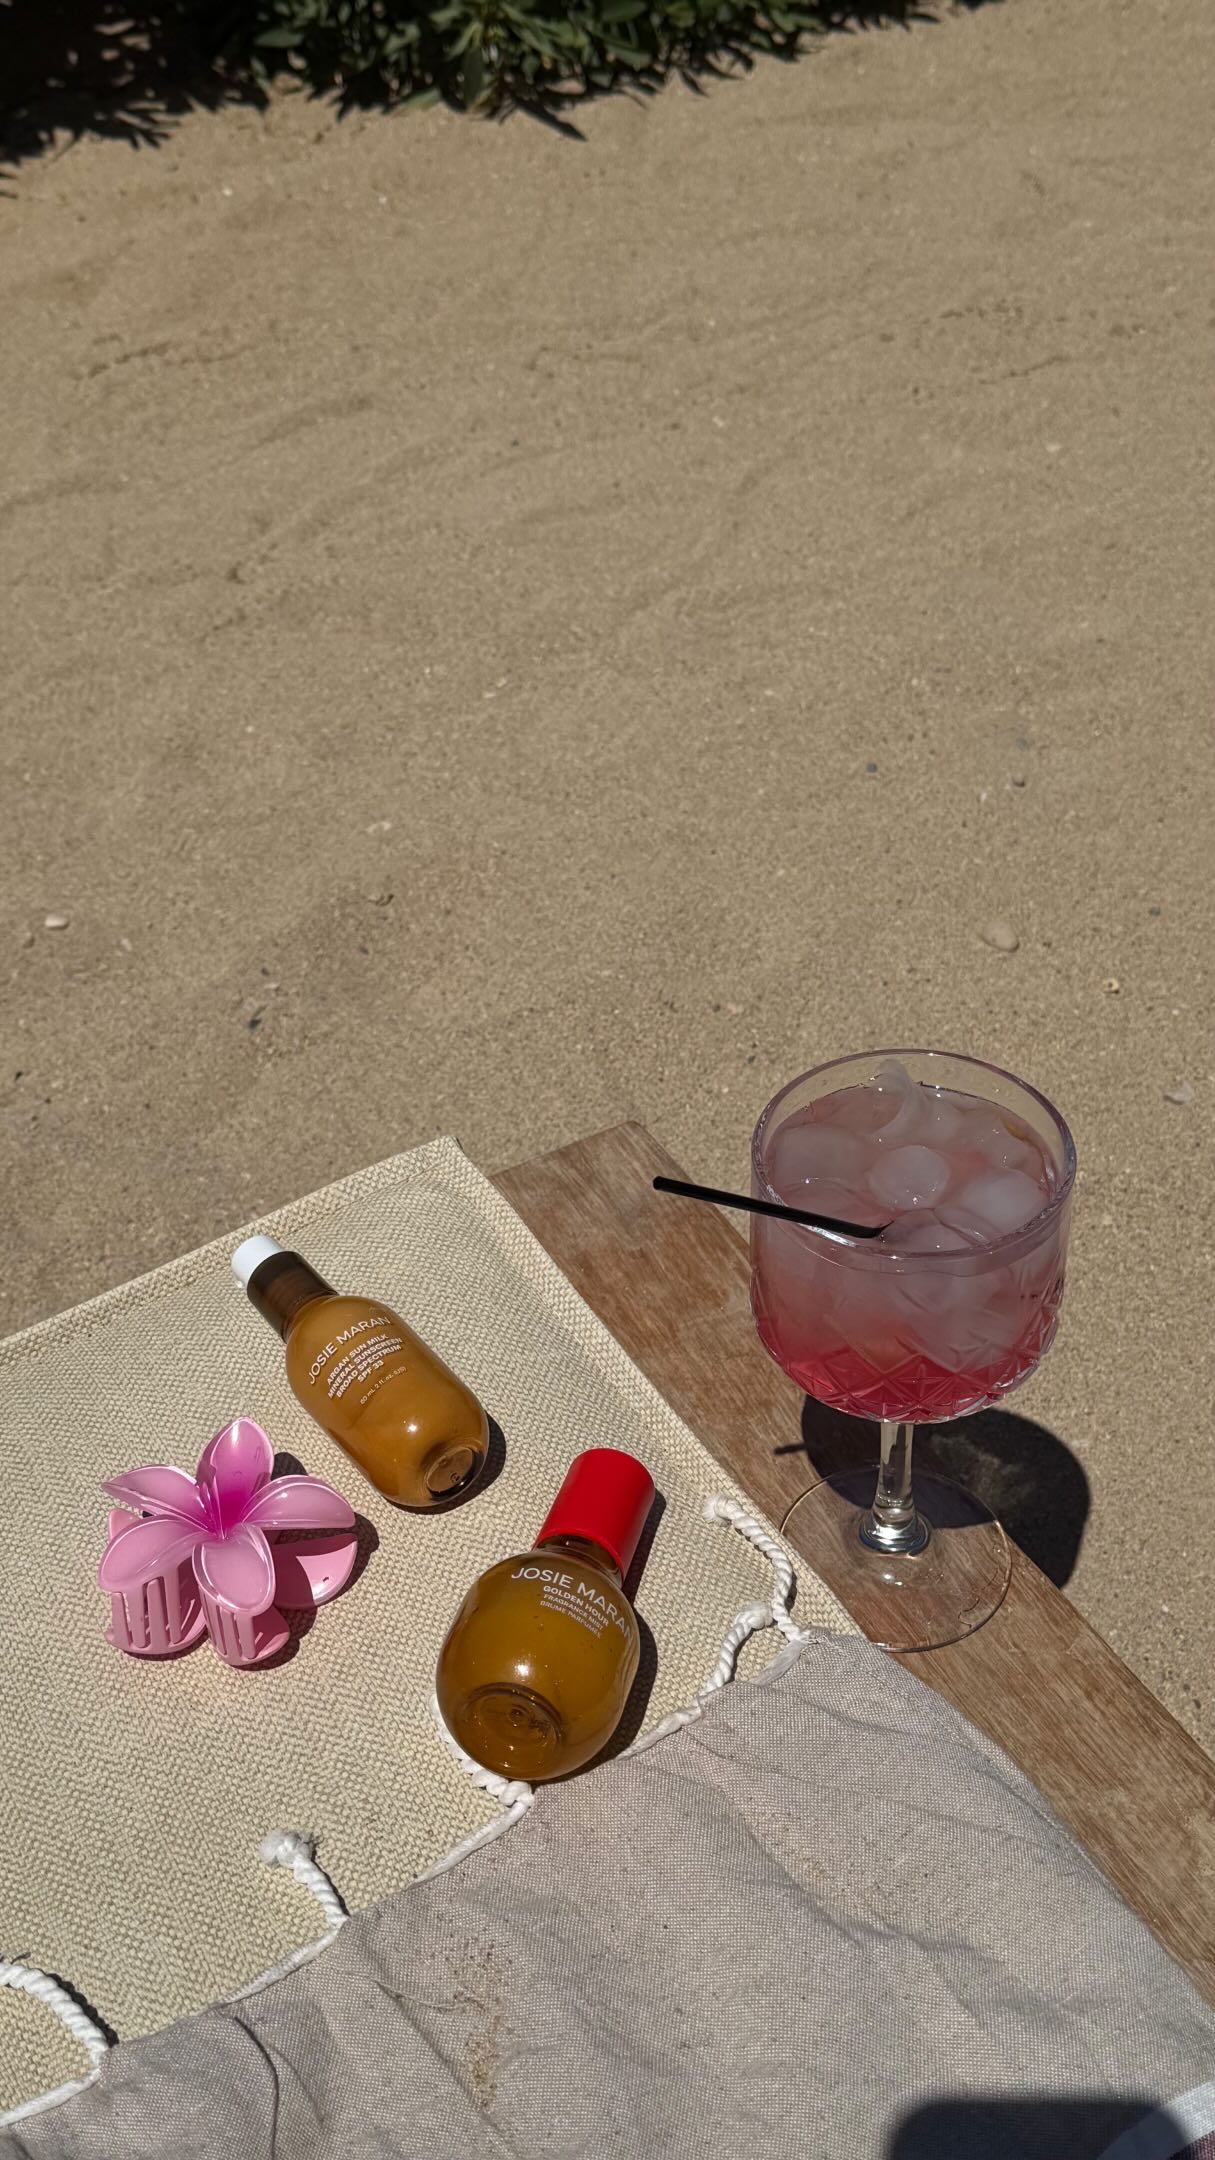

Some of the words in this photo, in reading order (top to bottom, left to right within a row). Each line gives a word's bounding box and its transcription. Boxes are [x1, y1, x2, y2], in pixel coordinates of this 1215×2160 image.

[307, 1342, 338, 1385] JOSIE
[335, 1316, 391, 1345] MARAN
[326, 1356, 350, 1385] ARGAN
[349, 1343, 366, 1358] SUN
[367, 1333, 389, 1346] MILK
[327, 1363, 356, 1399] MINERAL
[354, 1338, 403, 1364] SUNSCREEN
[336, 1370, 359, 1398] BROAD
[358, 1345, 402, 1371] SPECTRUM
[357, 1368, 373, 1383] SPF
[372, 1360, 385, 1370] 33
[511, 1567, 574, 1589] JOSIE
[543, 1585, 584, 1607] GOLDEN
[585, 1602, 609, 1627] HOUR
[543, 1594, 589, 1618] FRAGRANCE
